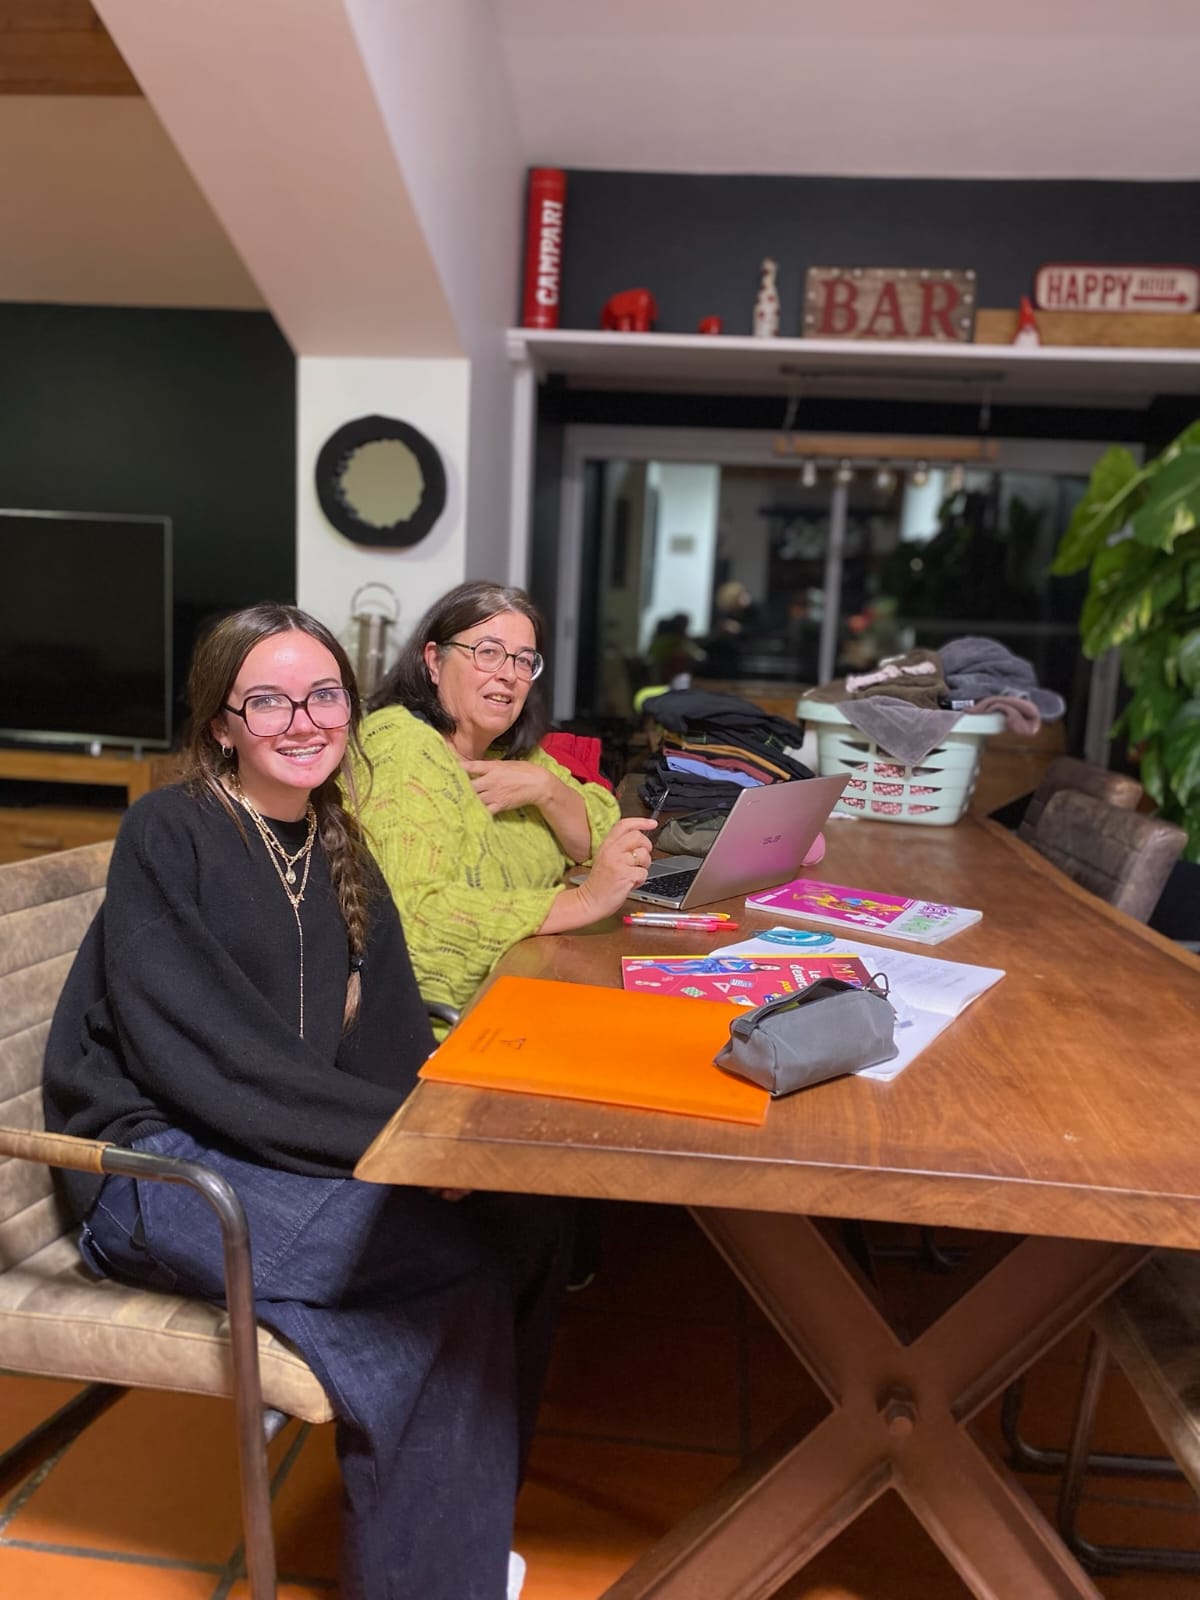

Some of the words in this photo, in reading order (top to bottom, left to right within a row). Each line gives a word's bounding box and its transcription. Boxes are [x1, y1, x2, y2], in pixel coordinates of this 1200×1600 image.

[536, 199, 563, 306] CAMPARI
[816, 278, 961, 339] BAR
[1047, 272, 1133, 308] HAPPY
